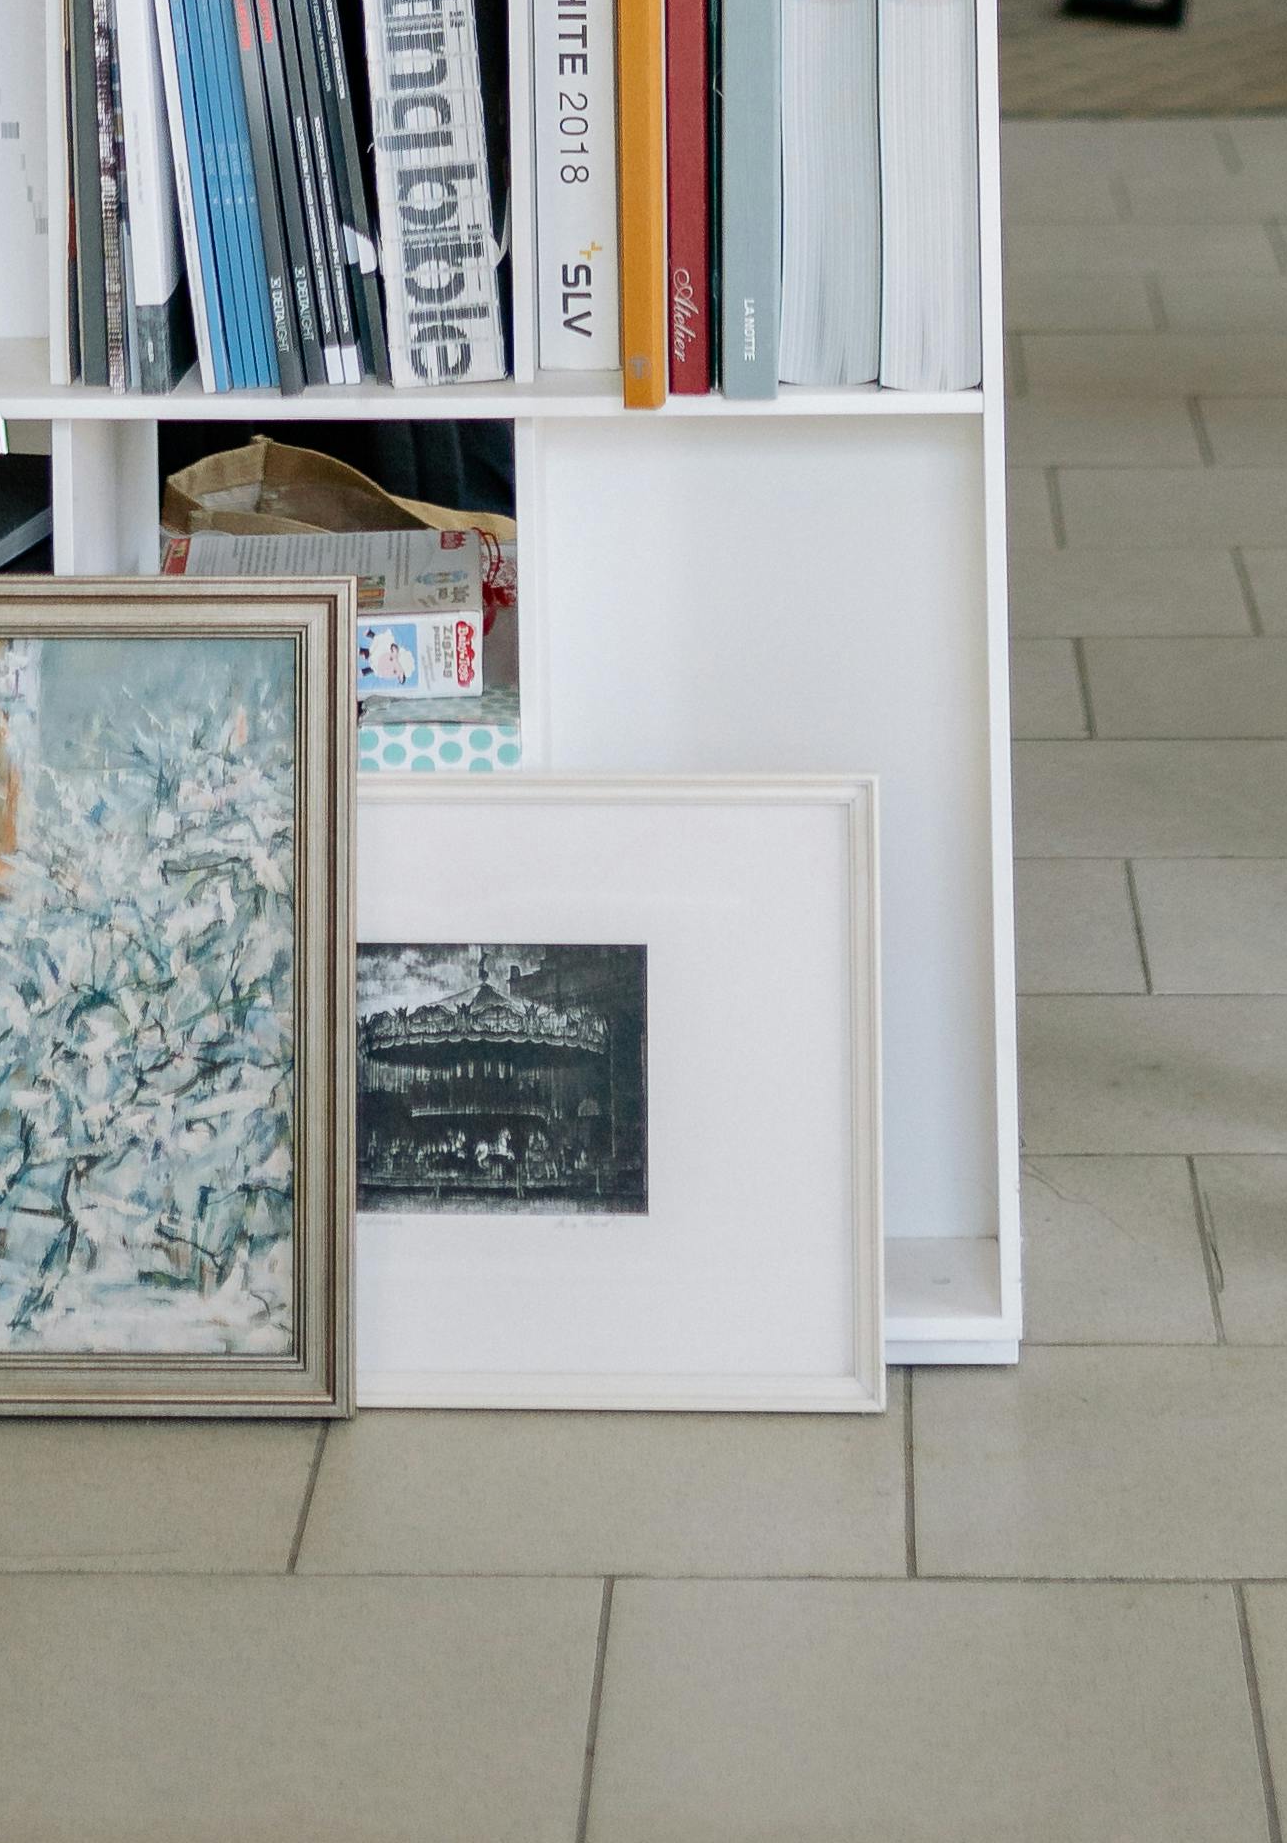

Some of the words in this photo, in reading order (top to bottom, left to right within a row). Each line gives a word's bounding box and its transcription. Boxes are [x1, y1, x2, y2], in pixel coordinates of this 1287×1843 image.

[317, 36, 326, 51] NEW
[333, 44, 341, 58] NEW
[319, 52, 332, 92] COLLECTION
[334, 59, 346, 100] COLLECTION
[559, 92, 591, 186] 2018
[397, 162, 490, 381] bible
[296, 280, 314, 341] DELTALIGHT
[560, 263, 594, 339] SLV
[672, 267, 699, 363] Atelier
[743, 298, 756, 316] LA
[743, 316, 756, 362] NOTTE
[432, 625, 443, 664] puzzle
[442, 624, 455, 679] ZigZag
